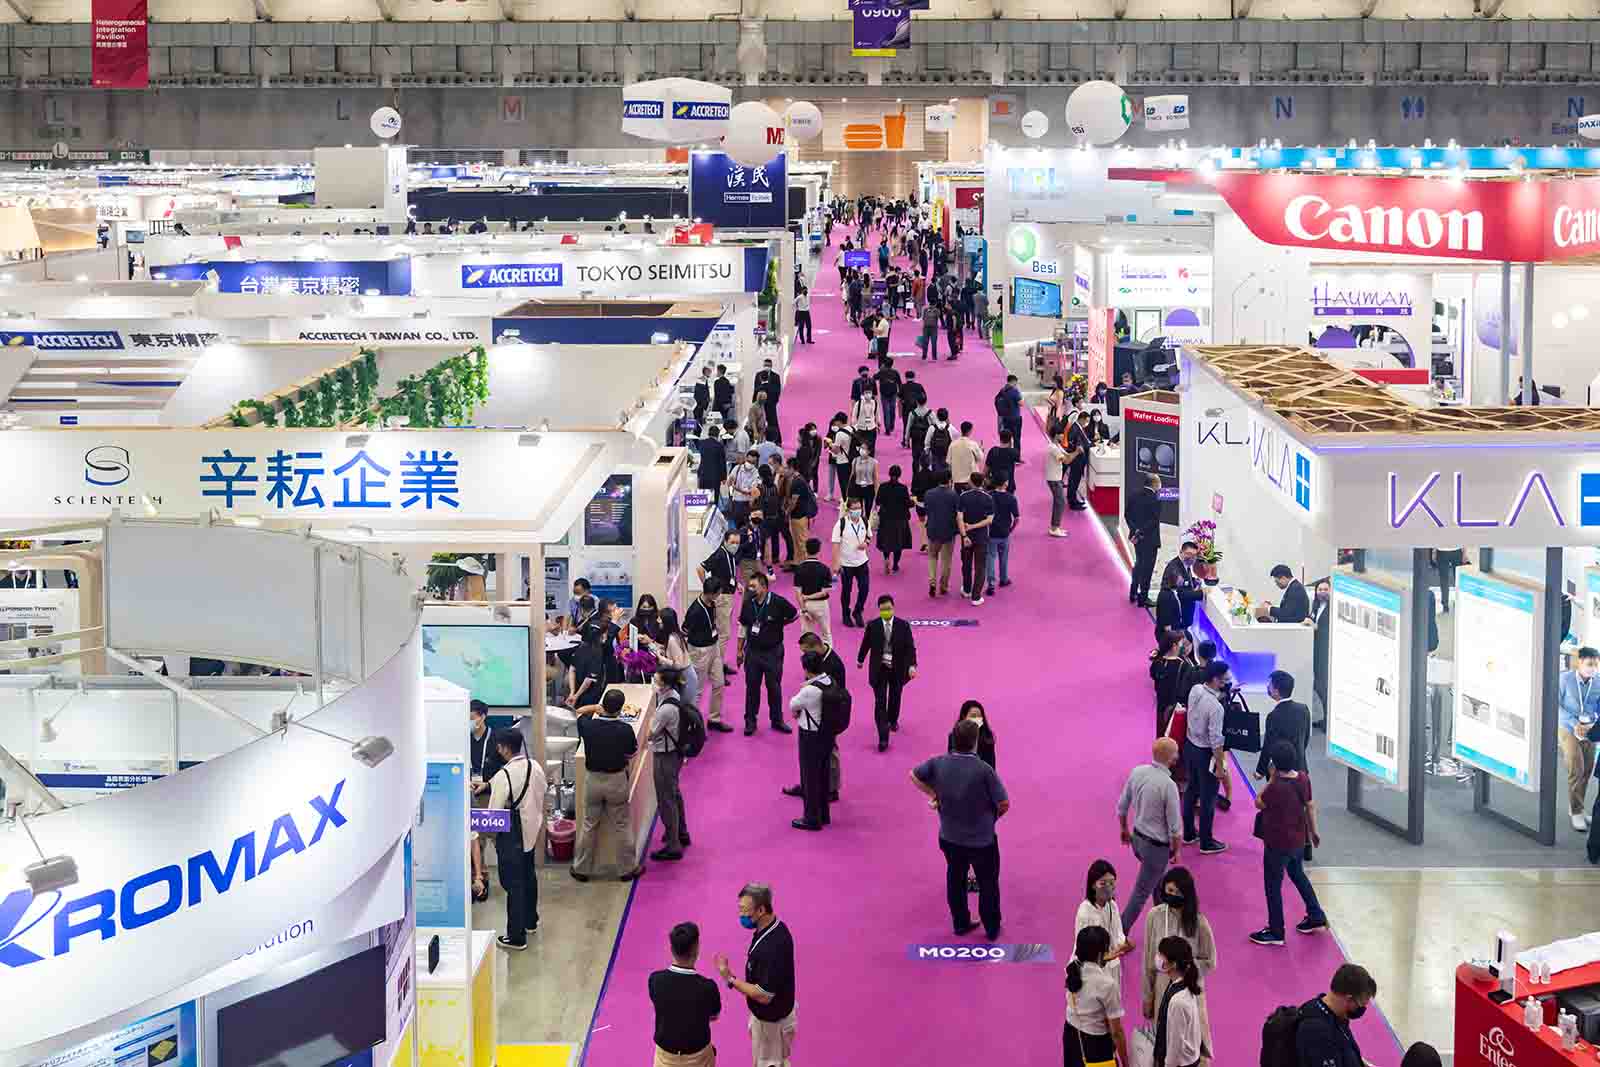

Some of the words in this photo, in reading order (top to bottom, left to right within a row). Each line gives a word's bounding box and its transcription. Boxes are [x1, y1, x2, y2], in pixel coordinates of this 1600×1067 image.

[628, 104, 661, 117] ACCRETECH
[690, 103, 729, 118] ACCRETECH
[727, 164, 770, 188] 漢民
[1284, 194, 1483, 251] Canon
[488, 266, 559, 284] ACCRETECH
[576, 264, 643, 283] TOKYO
[648, 262, 732, 281] SEIMITSU
[1032, 261, 1056, 274] Besi
[32, 334, 119, 348] ACCRETECH
[299, 331, 367, 341] ACCRETECH
[369, 331, 421, 341] TAIWAN
[425, 331, 449, 341] CO.,
[452, 330, 479, 340] LTD.
[1132, 411, 1153, 420] Wafer
[1153, 415, 1179, 425] Loading
[1198, 421, 1251, 445] KL
[199, 448, 460, 509] 辛耘企業
[53, 495, 163, 505] SCIENTEH
[1388, 470, 1567, 528] KLA
[471, 818, 479, 826] M
[481, 818, 505, 826] 0140
[919, 947, 1006, 958] M0200
